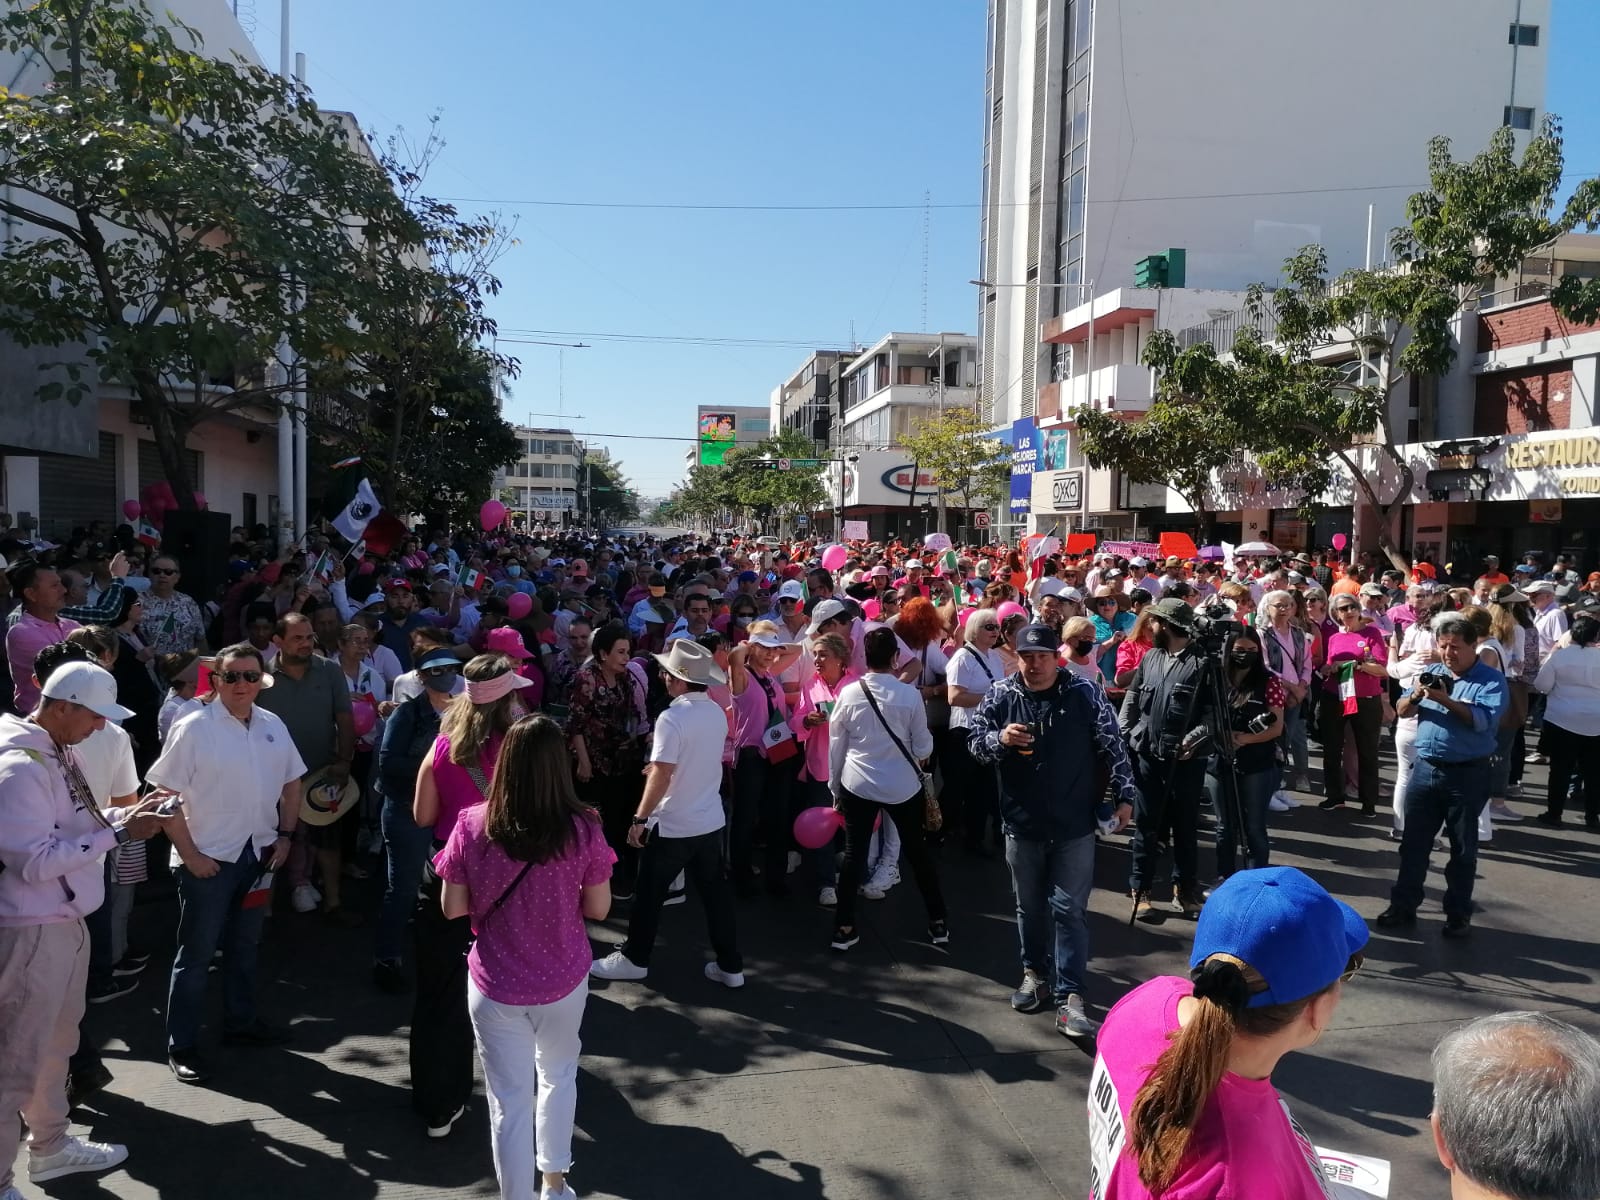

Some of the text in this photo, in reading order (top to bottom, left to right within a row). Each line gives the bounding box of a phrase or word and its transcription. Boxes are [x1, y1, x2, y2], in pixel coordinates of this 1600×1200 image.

[1018, 437, 1031, 449] LAS
[1012, 449, 1037, 462] MEJORES
[1505, 436, 1600, 469] RESTAUR
[1012, 462, 1036, 475] MARCAS
[1053, 479, 1077, 502] OXXO
[1095, 1070, 1112, 1113] NO
